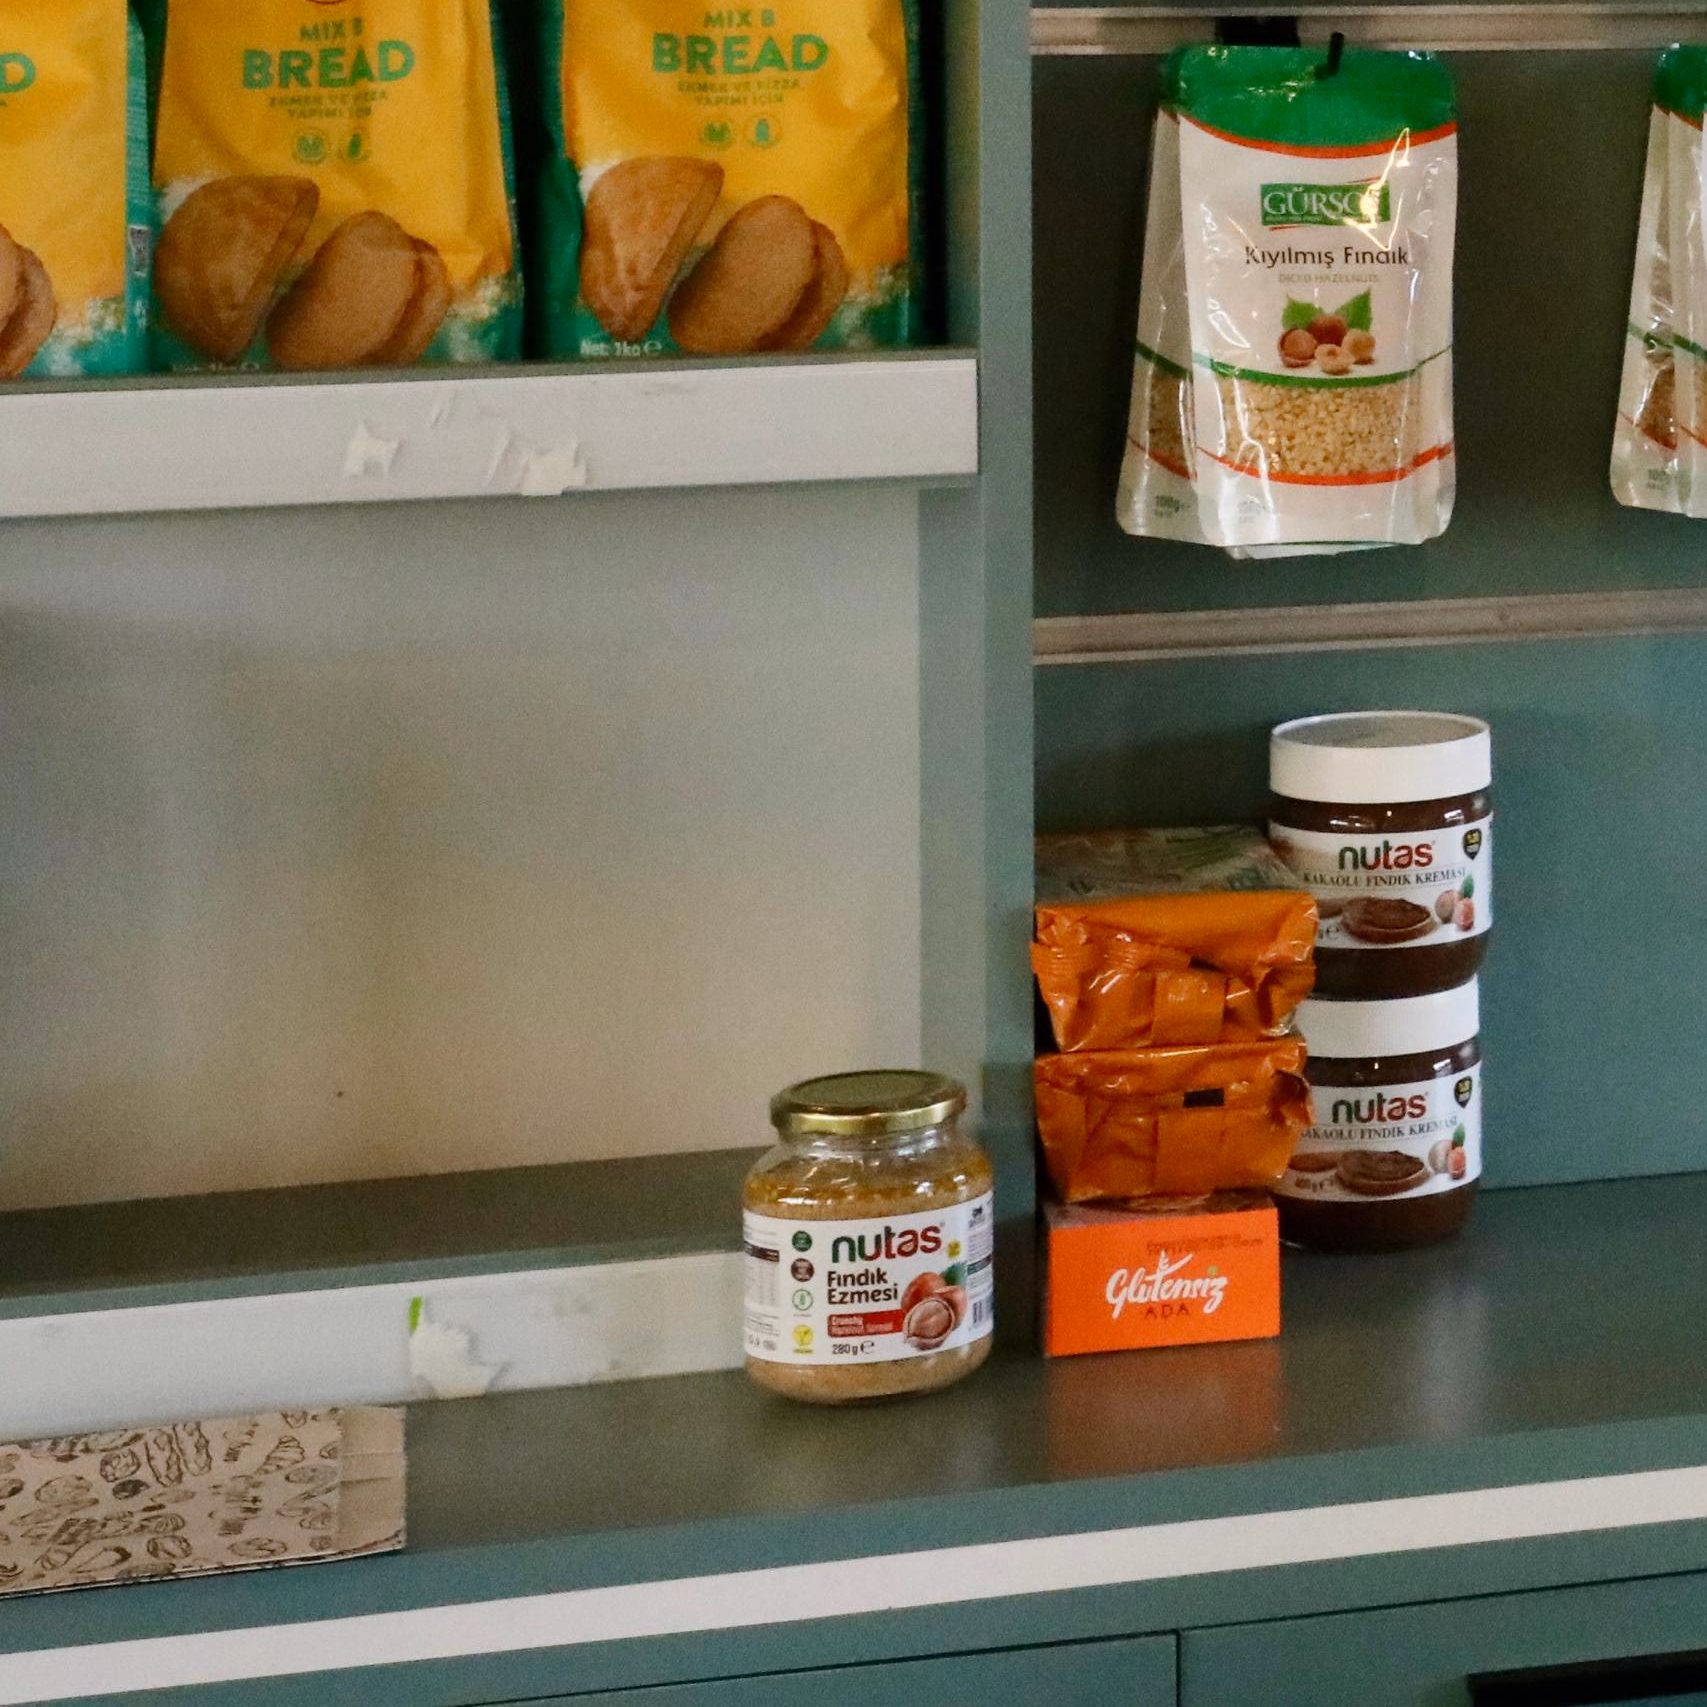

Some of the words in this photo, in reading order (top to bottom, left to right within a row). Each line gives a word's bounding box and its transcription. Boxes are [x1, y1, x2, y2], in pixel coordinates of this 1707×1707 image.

[703, 9, 752, 29] MIX
[242, 40, 416, 89] BREAD
[652, 32, 829, 75] BREAD
[1245, 246, 1334, 269] Kıyılmış
[1338, 840, 1434, 871] nutas
[1303, 873, 1359, 887] KAKAOLU
[1366, 874, 1412, 887] FINDIK
[1331, 1093, 1427, 1124] nutas
[1360, 1125, 1404, 1140] FINDIK
[831, 1223, 943, 1264] nutas
[827, 1267, 888, 1287] Fındık
[827, 1283, 898, 1305] Ezmesi
[1143, 1303, 1190, 1320] ADA
